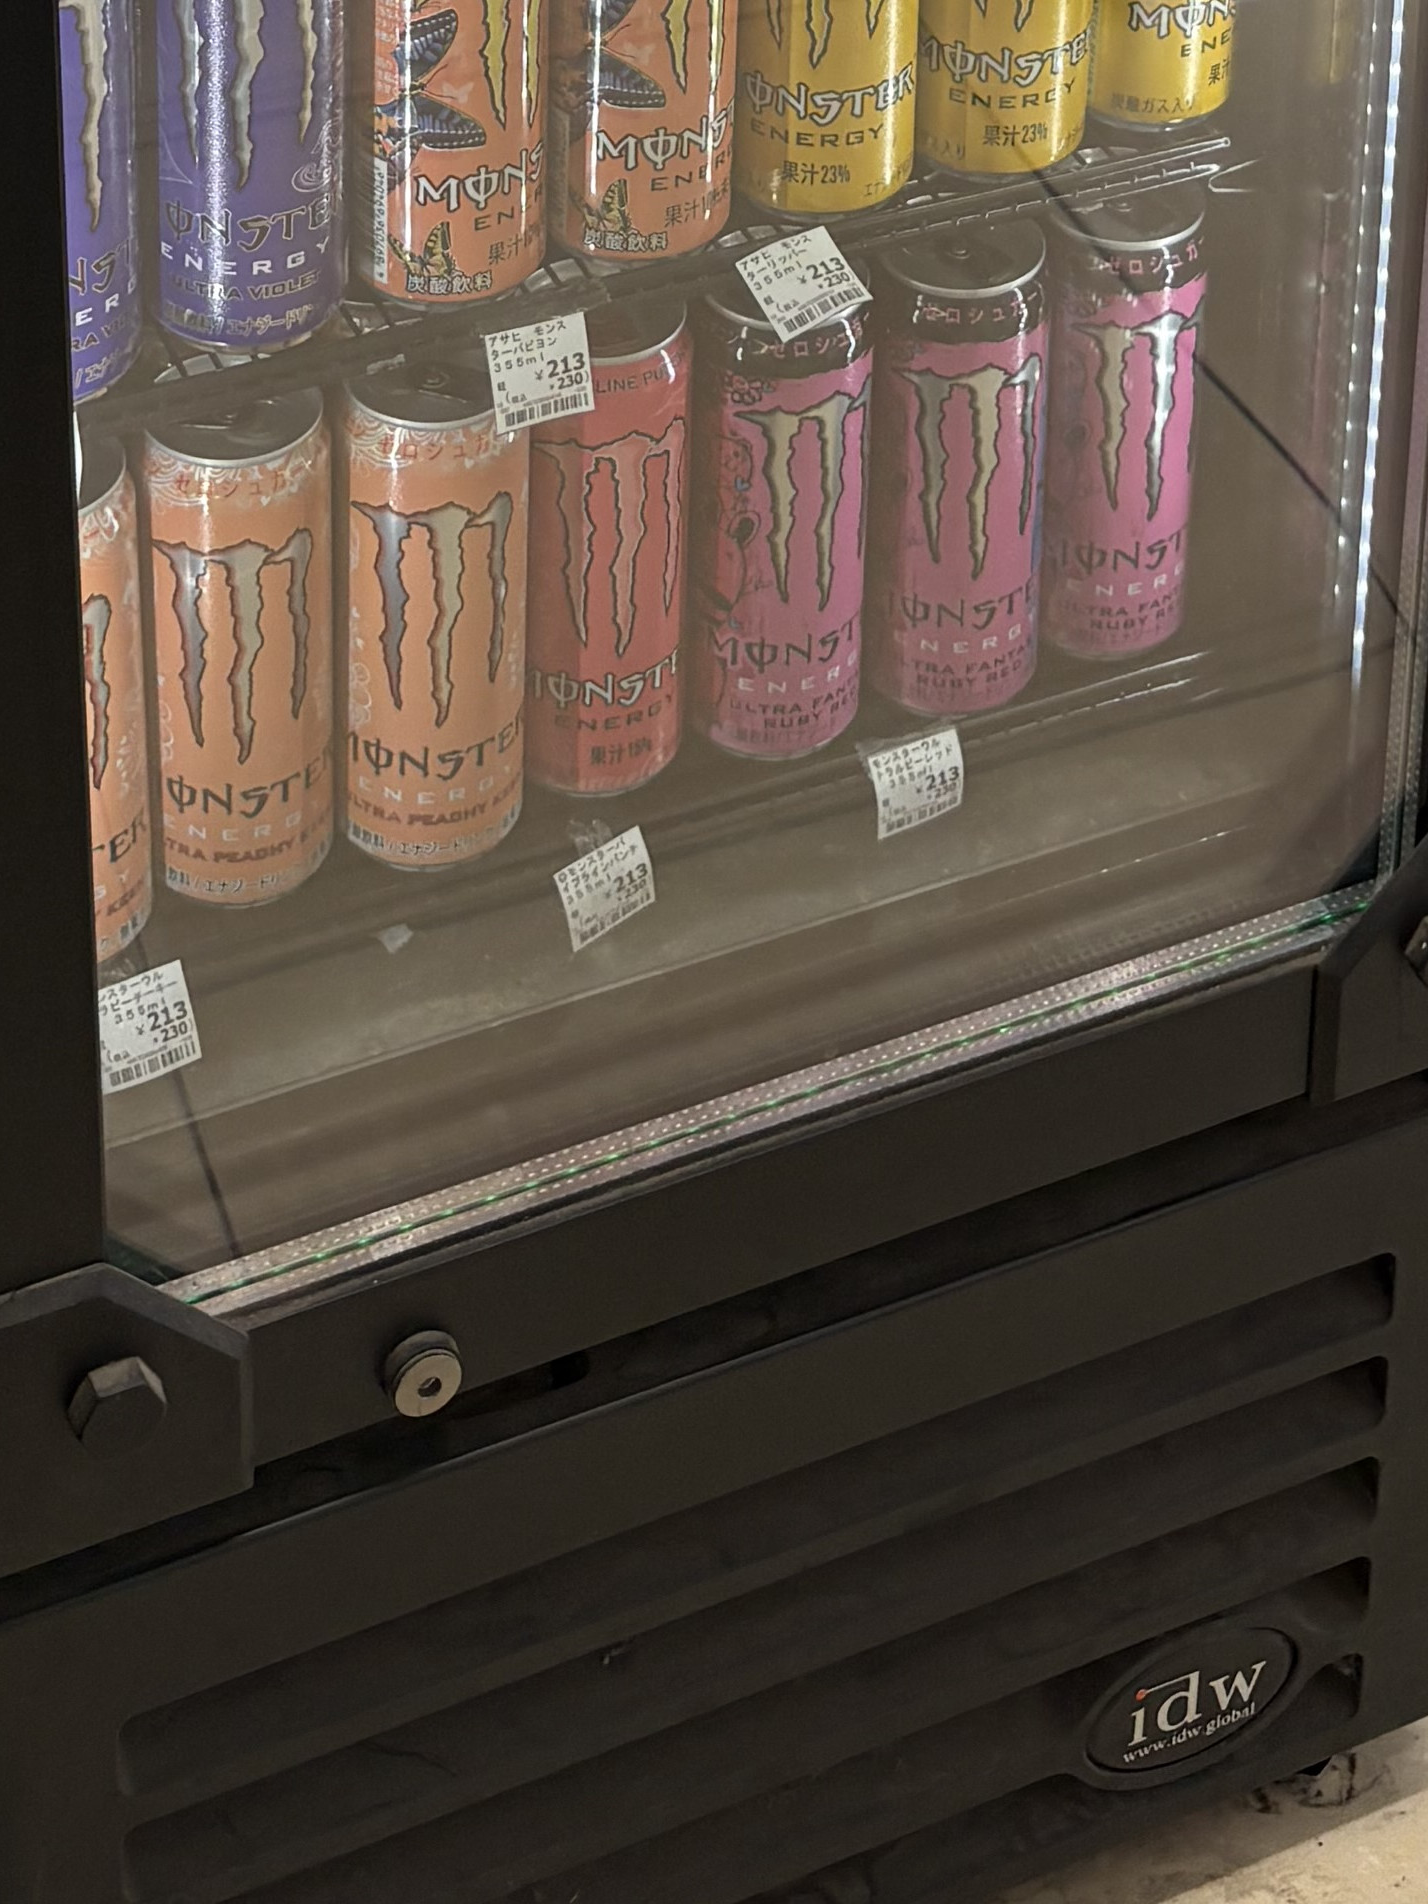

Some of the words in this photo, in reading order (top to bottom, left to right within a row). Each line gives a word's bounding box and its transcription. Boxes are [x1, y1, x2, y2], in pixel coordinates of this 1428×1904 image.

[744, 60, 917, 127] ONSTER
[797, 256, 846, 285] ¥213
[534, 352, 586, 381] ¥213
[135, 999, 188, 1036] ¥213
[1126, 1660, 1267, 1747] idw
[1121, 1701, 1257, 1765] www.idw.global
